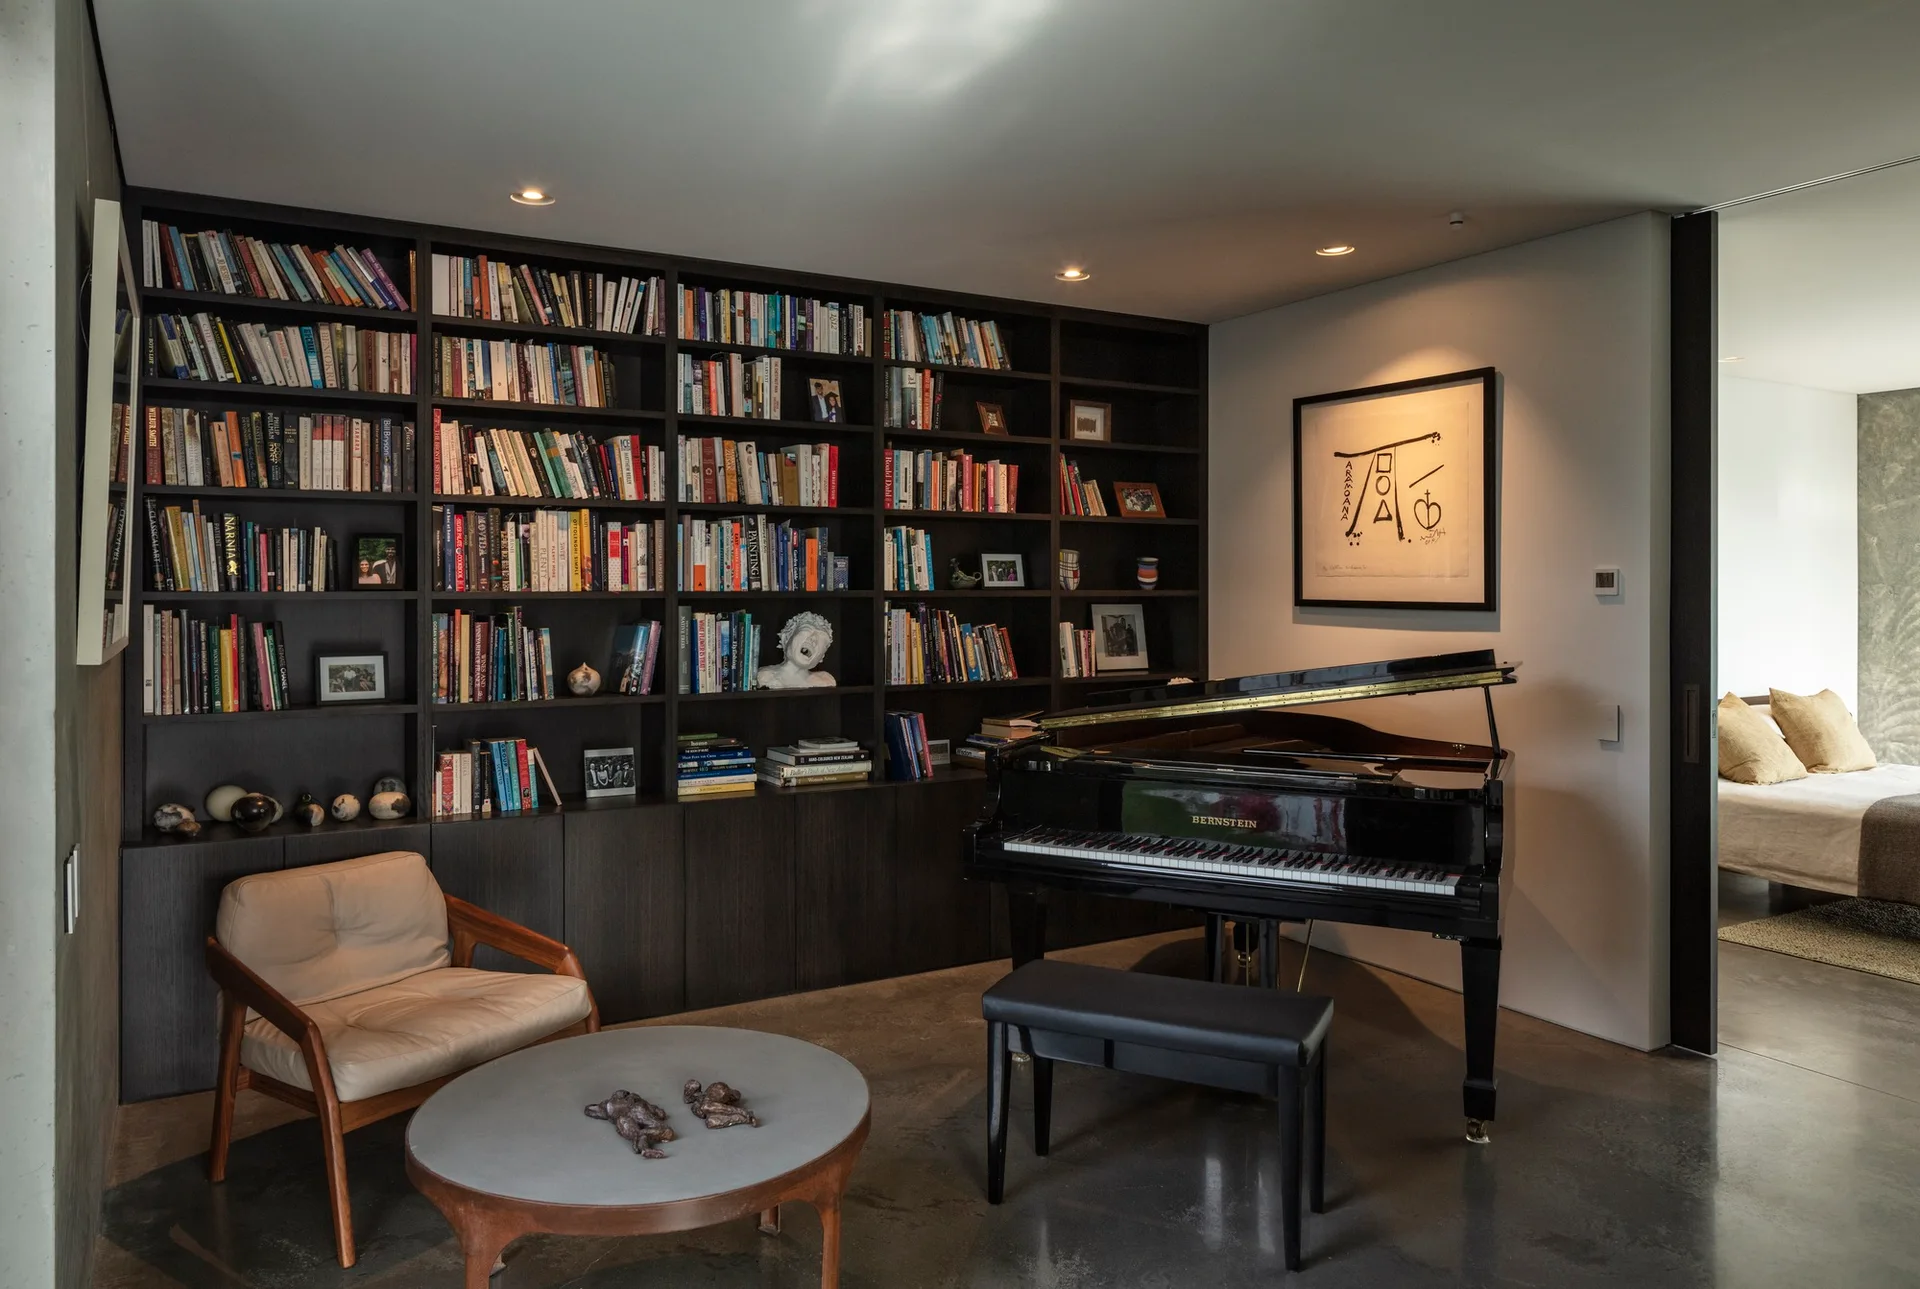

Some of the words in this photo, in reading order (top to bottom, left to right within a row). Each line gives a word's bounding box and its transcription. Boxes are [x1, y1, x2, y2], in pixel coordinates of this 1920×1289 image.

[322, 332, 330, 352] BEN
[324, 355, 336, 382] OKRI
[148, 408, 156, 428] WILBUR
[383, 420, 391, 430] Bill
[149, 428, 157, 447] SMITH
[382, 431, 391, 455] Bryson
[1340, 460, 1354, 521] ARAMOANA
[149, 510, 159, 550] CLASSICAL
[214, 523, 222, 547] PATIENT
[224, 516, 236, 559] NARNIA
[152, 550, 161, 563] ART
[748, 530, 759, 576] PAINTING
[278, 644, 286, 667] INTIMATE
[280, 667, 288, 690] CHANEL
[1192, 816, 1257, 828] BERNSTEIN
